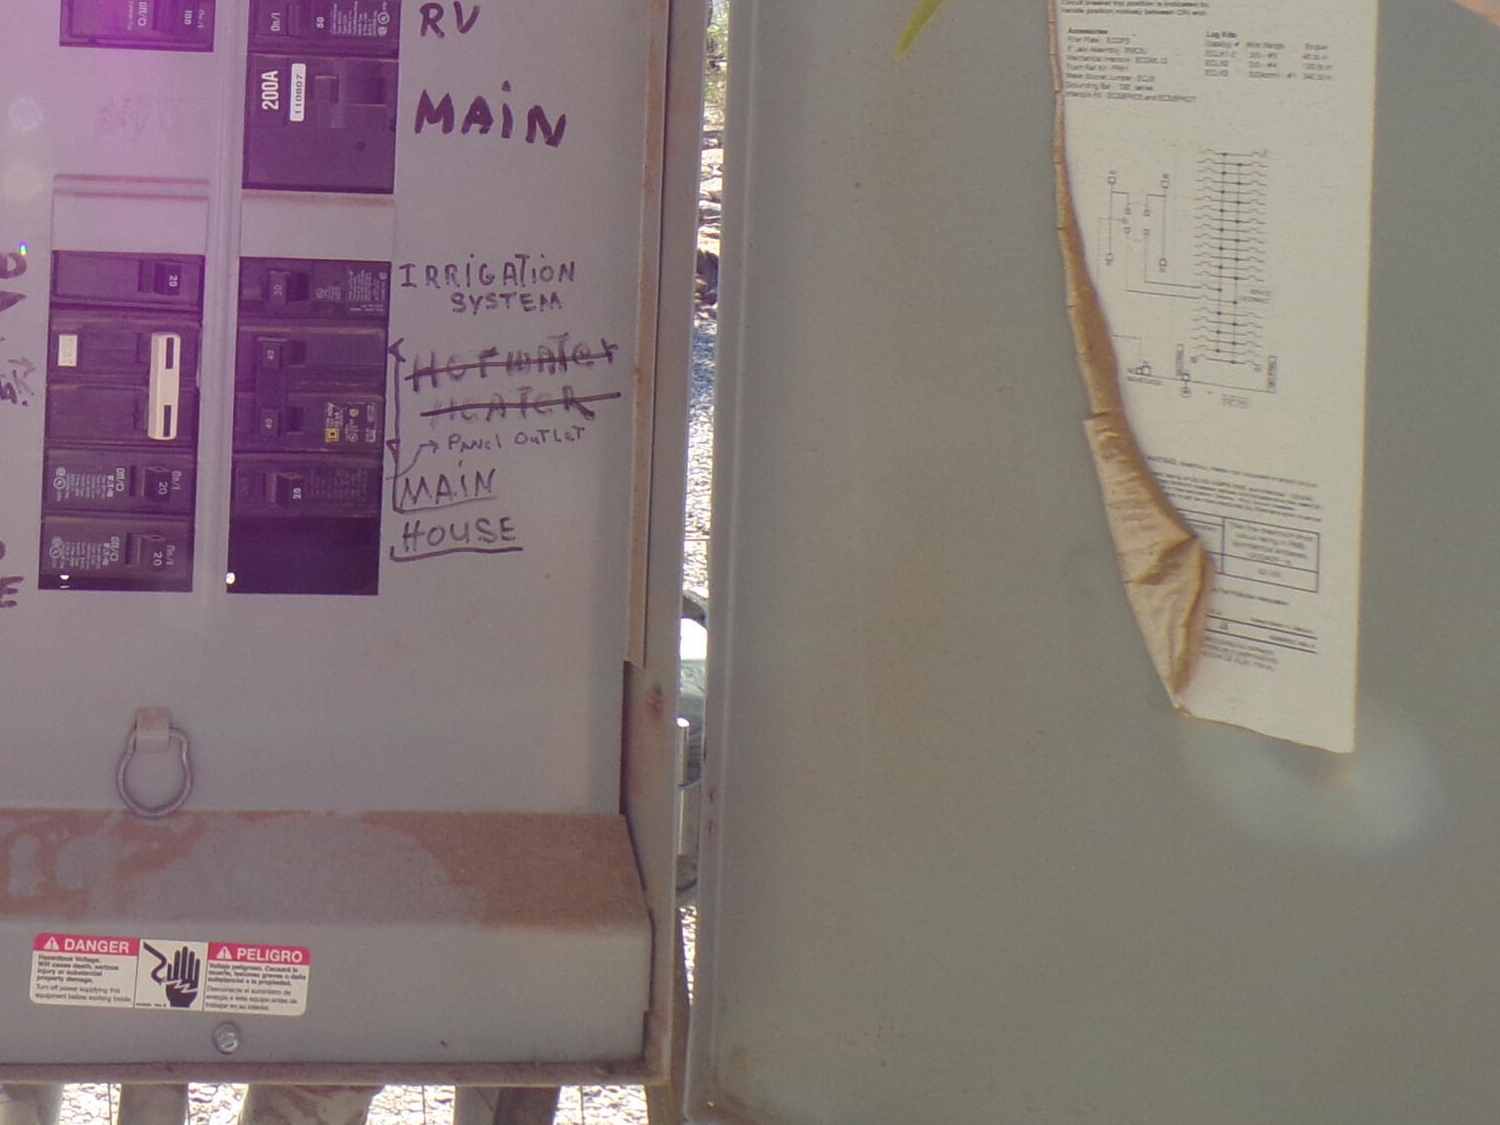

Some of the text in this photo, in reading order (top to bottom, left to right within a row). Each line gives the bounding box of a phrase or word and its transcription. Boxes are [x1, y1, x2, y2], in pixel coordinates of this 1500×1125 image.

[419, 1, 481, 38] RV
[261, 69, 279, 111] 200A
[294, 73, 303, 115] 110807
[168, 273, 178, 288] 20
[450, 291, 563, 315] SYSTEM
[157, 480, 168, 495] 20
[292, 486, 302, 500] 20
[402, 516, 516, 553] HOUSE
[153, 551, 162, 567] 20
[64, 938, 130, 954] DANGER
[237, 948, 303, 963] PELIGRO
